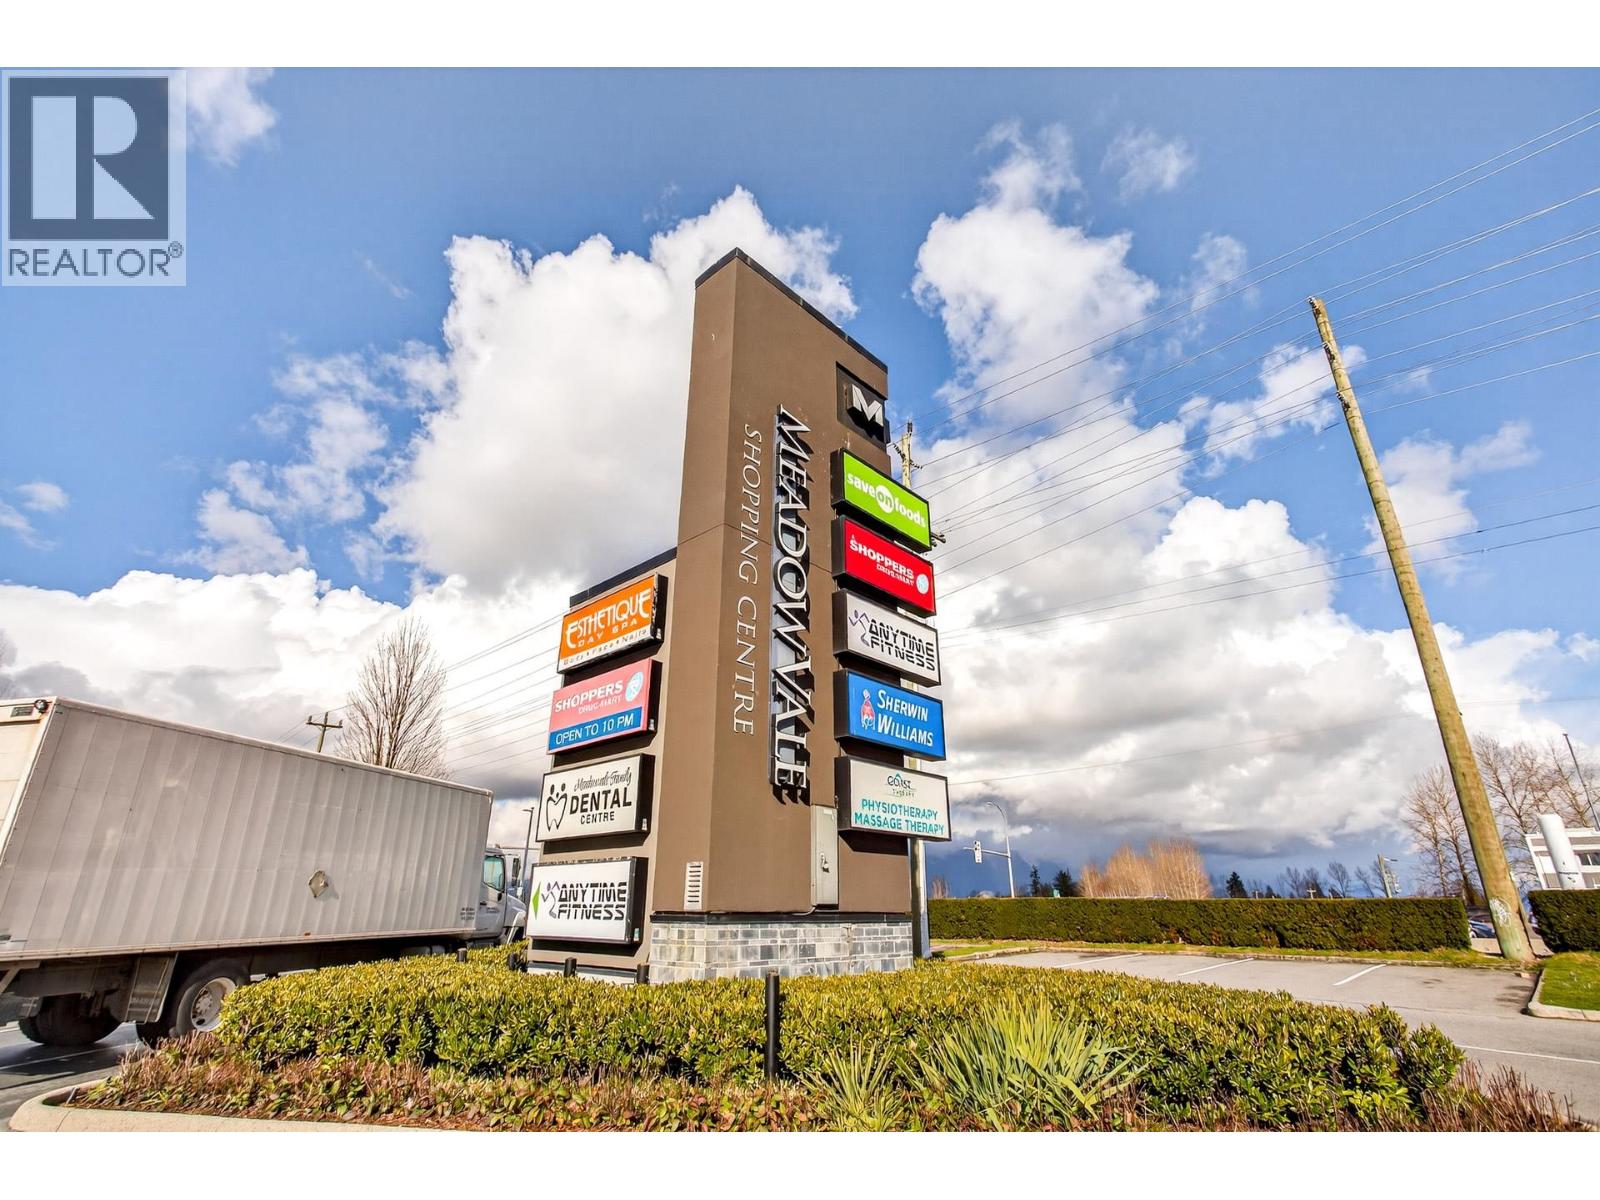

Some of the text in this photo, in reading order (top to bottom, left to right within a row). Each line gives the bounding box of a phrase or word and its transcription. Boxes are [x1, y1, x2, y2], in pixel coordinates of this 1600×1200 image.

[851, 384, 884, 427] M
[849, 539, 915, 580] SHOPPERS
[733, 423, 763, 735] SHOPPING CENTRE
[774, 403, 812, 789] MEADOWVALE
[566, 588, 652, 649] ESTHETIQUE
[578, 618, 637, 648] DAY SPA
[869, 619, 935, 658] ANYTIME
[870, 636, 936, 671] FITNESS
[555, 680, 623, 713] SHOPPERS
[877, 689, 929, 722] SHERWIN
[555, 713, 634, 745] OPEN TO 10 PM
[877, 713, 934, 747] WILLIAMS
[569, 787, 632, 815] DENTAL
[861, 798, 938, 820] PHYSIOTHERAPY
[580, 811, 615, 825] CENTRE
[854, 812, 944, 835] MASSAGE THERAPY
[558, 881, 627, 902] ANYTIME
[557, 903, 626, 920] FITNESS
